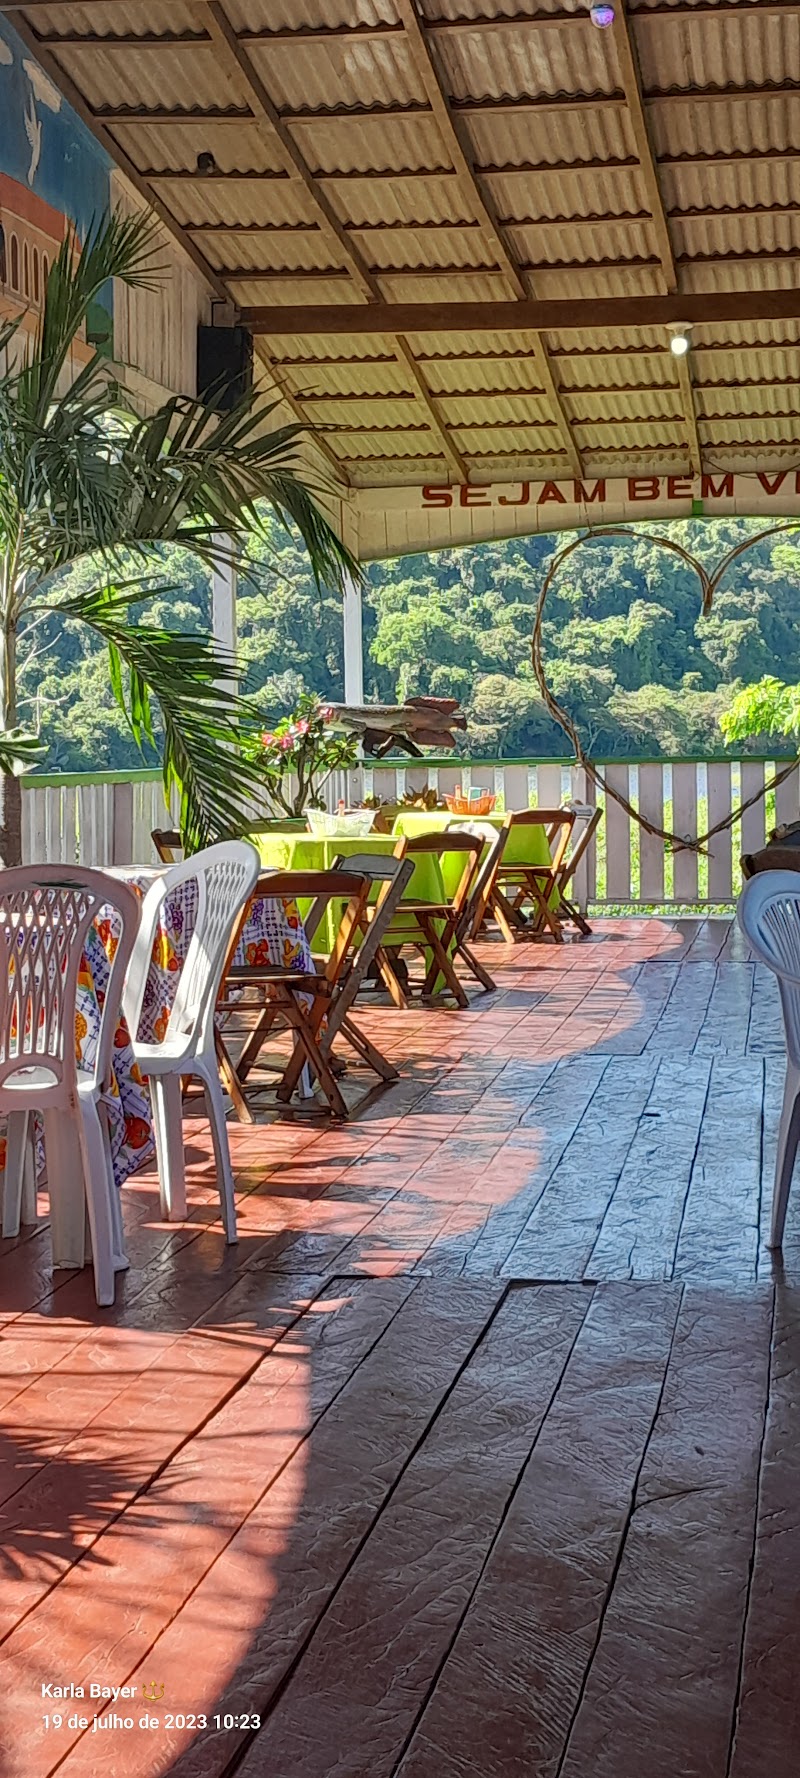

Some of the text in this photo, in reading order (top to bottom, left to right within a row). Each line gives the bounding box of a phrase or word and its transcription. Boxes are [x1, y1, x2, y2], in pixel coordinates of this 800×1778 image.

[421, 471, 800, 508] SEJAM BEM V
